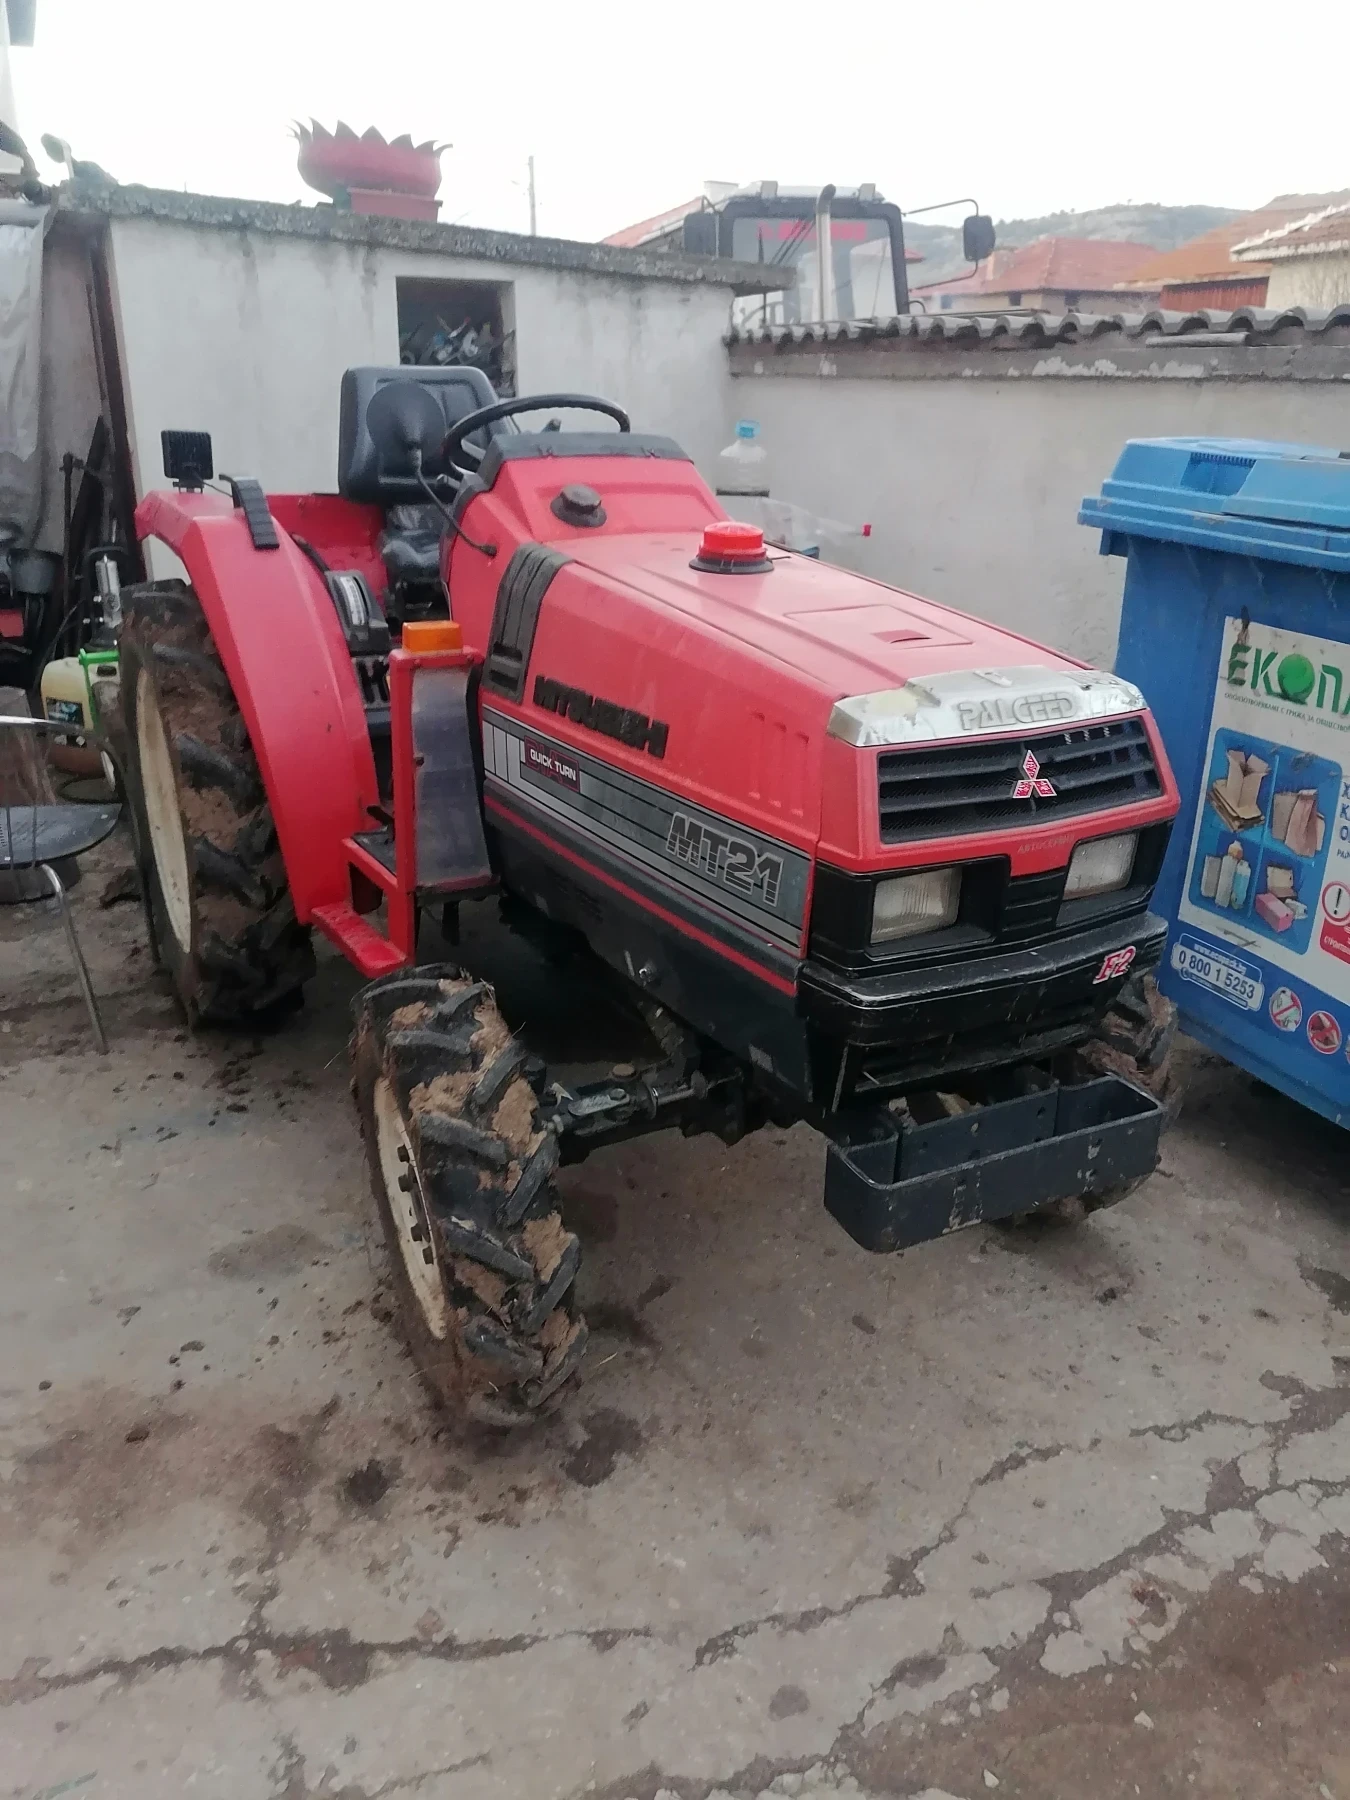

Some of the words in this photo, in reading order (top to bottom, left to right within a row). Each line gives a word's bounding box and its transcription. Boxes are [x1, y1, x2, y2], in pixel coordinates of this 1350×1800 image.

[530, 748, 553, 769] QUICK
[554, 760, 577, 781] TURN
[666, 811, 784, 907] MT21
[1092, 946, 1136, 985] F2
[1178, 950, 1186, 965] 0
[1189, 955, 1211, 976] 800
[1216, 968, 1221, 982] 1
[1224, 973, 1255, 999] 5253
